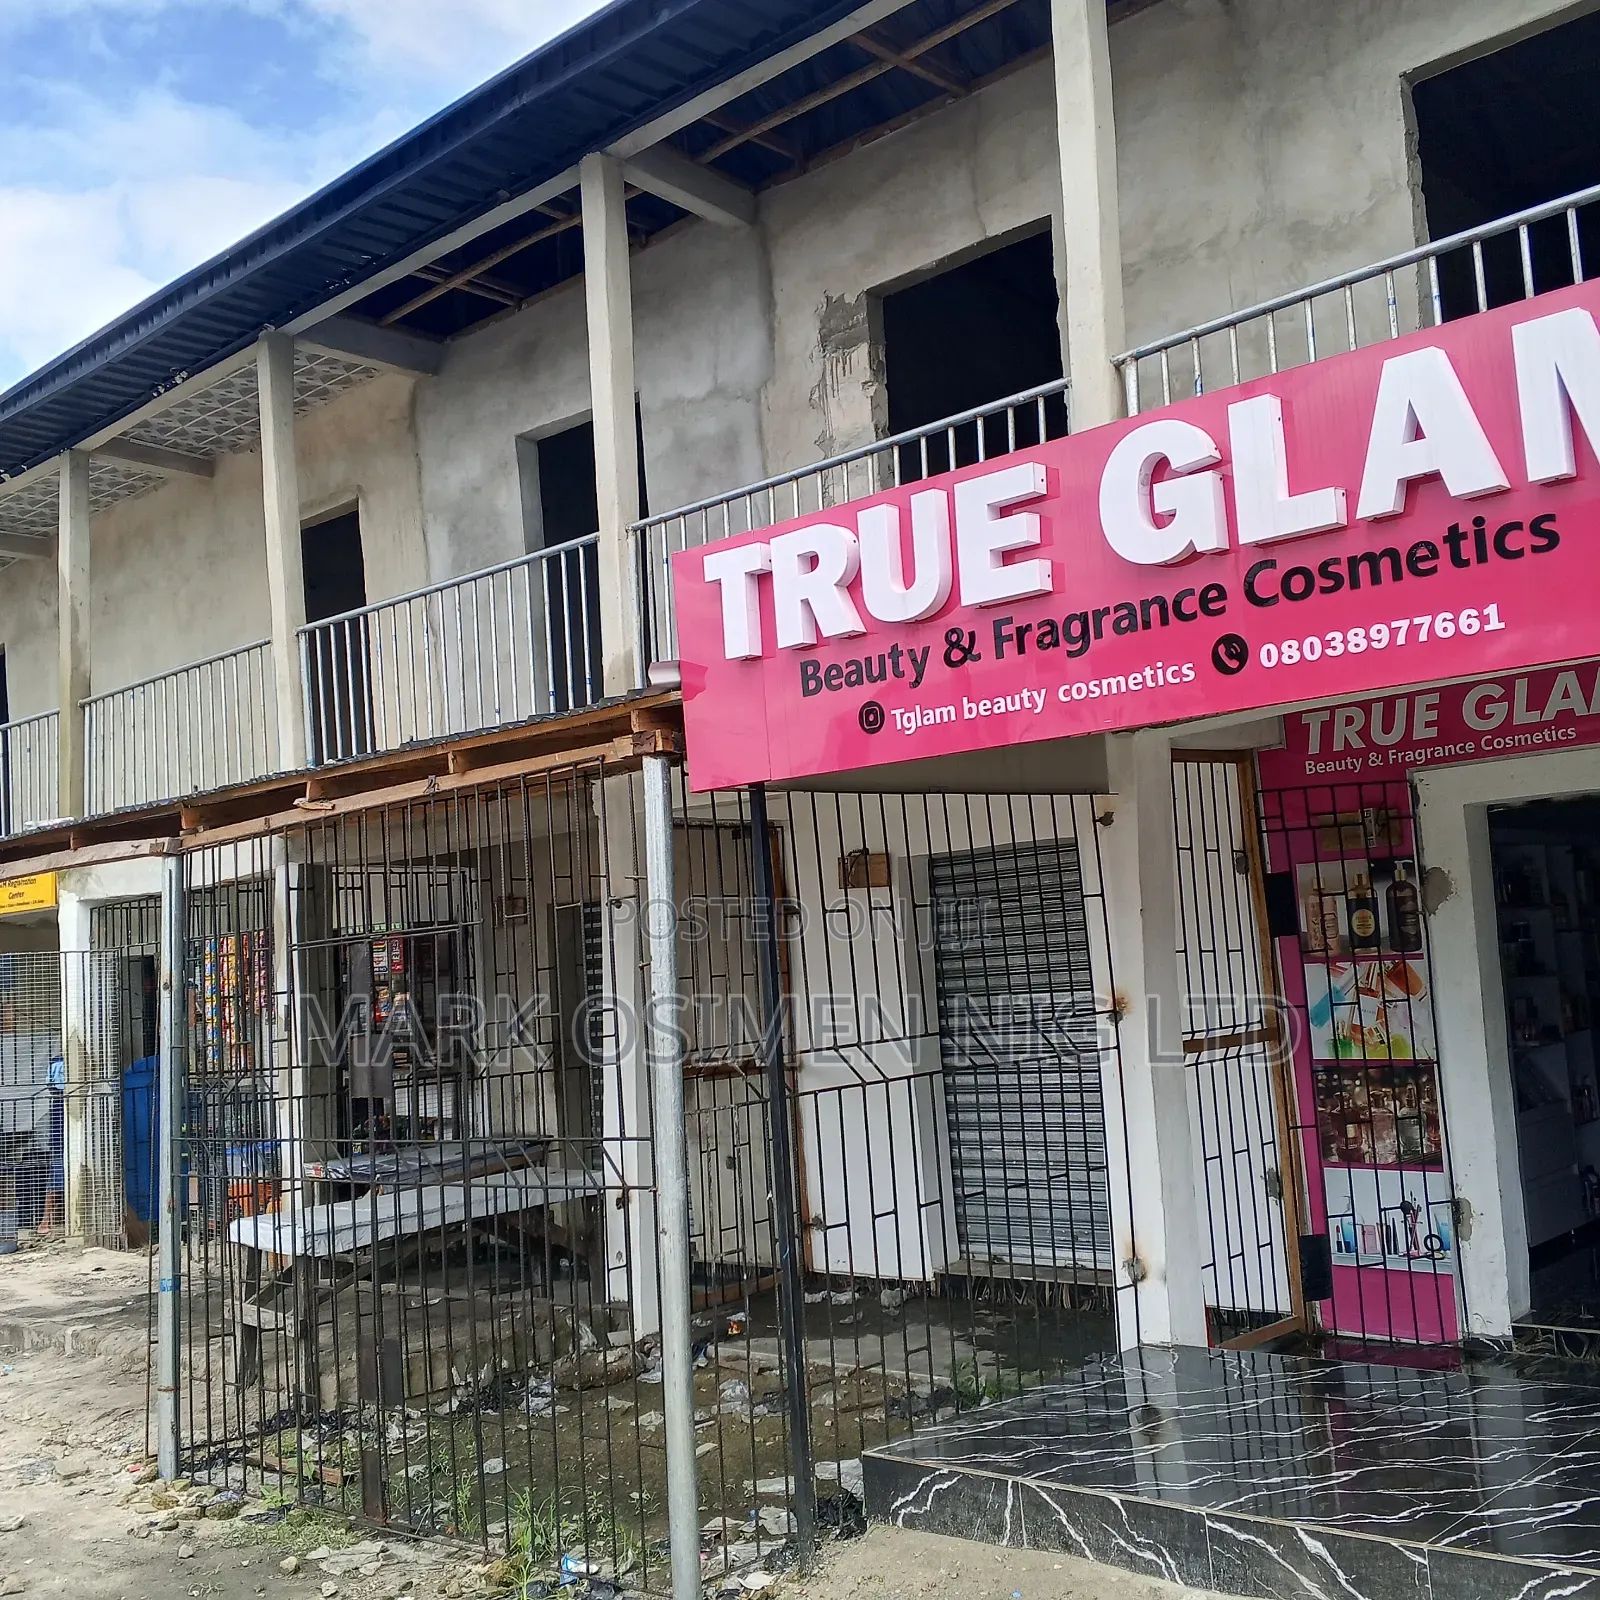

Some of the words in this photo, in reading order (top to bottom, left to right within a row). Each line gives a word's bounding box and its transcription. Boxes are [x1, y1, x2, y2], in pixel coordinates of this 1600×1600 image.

[703, 462, 1053, 661] TRUE
[800, 642, 931, 698] Beauty
[943, 627, 981, 668] &
[993, 583, 1228, 658] Fragrance
[1244, 513, 1561, 608] Cosmetics
[1259, 603, 1506, 669] 08038977661
[891, 703, 956, 735] Tglam
[963, 687, 1047, 720] beauty
[1058, 662, 1196, 702] cosmetics
[1301, 693, 1440, 755] TRUE
[1462, 667, 1600, 731] GLA
[1304, 754, 1362, 775] Beauty
[1368, 752, 1384, 767] &
[1388, 740, 1476, 766] Fragrance
[1480, 725, 1577, 750] Cosmetics
